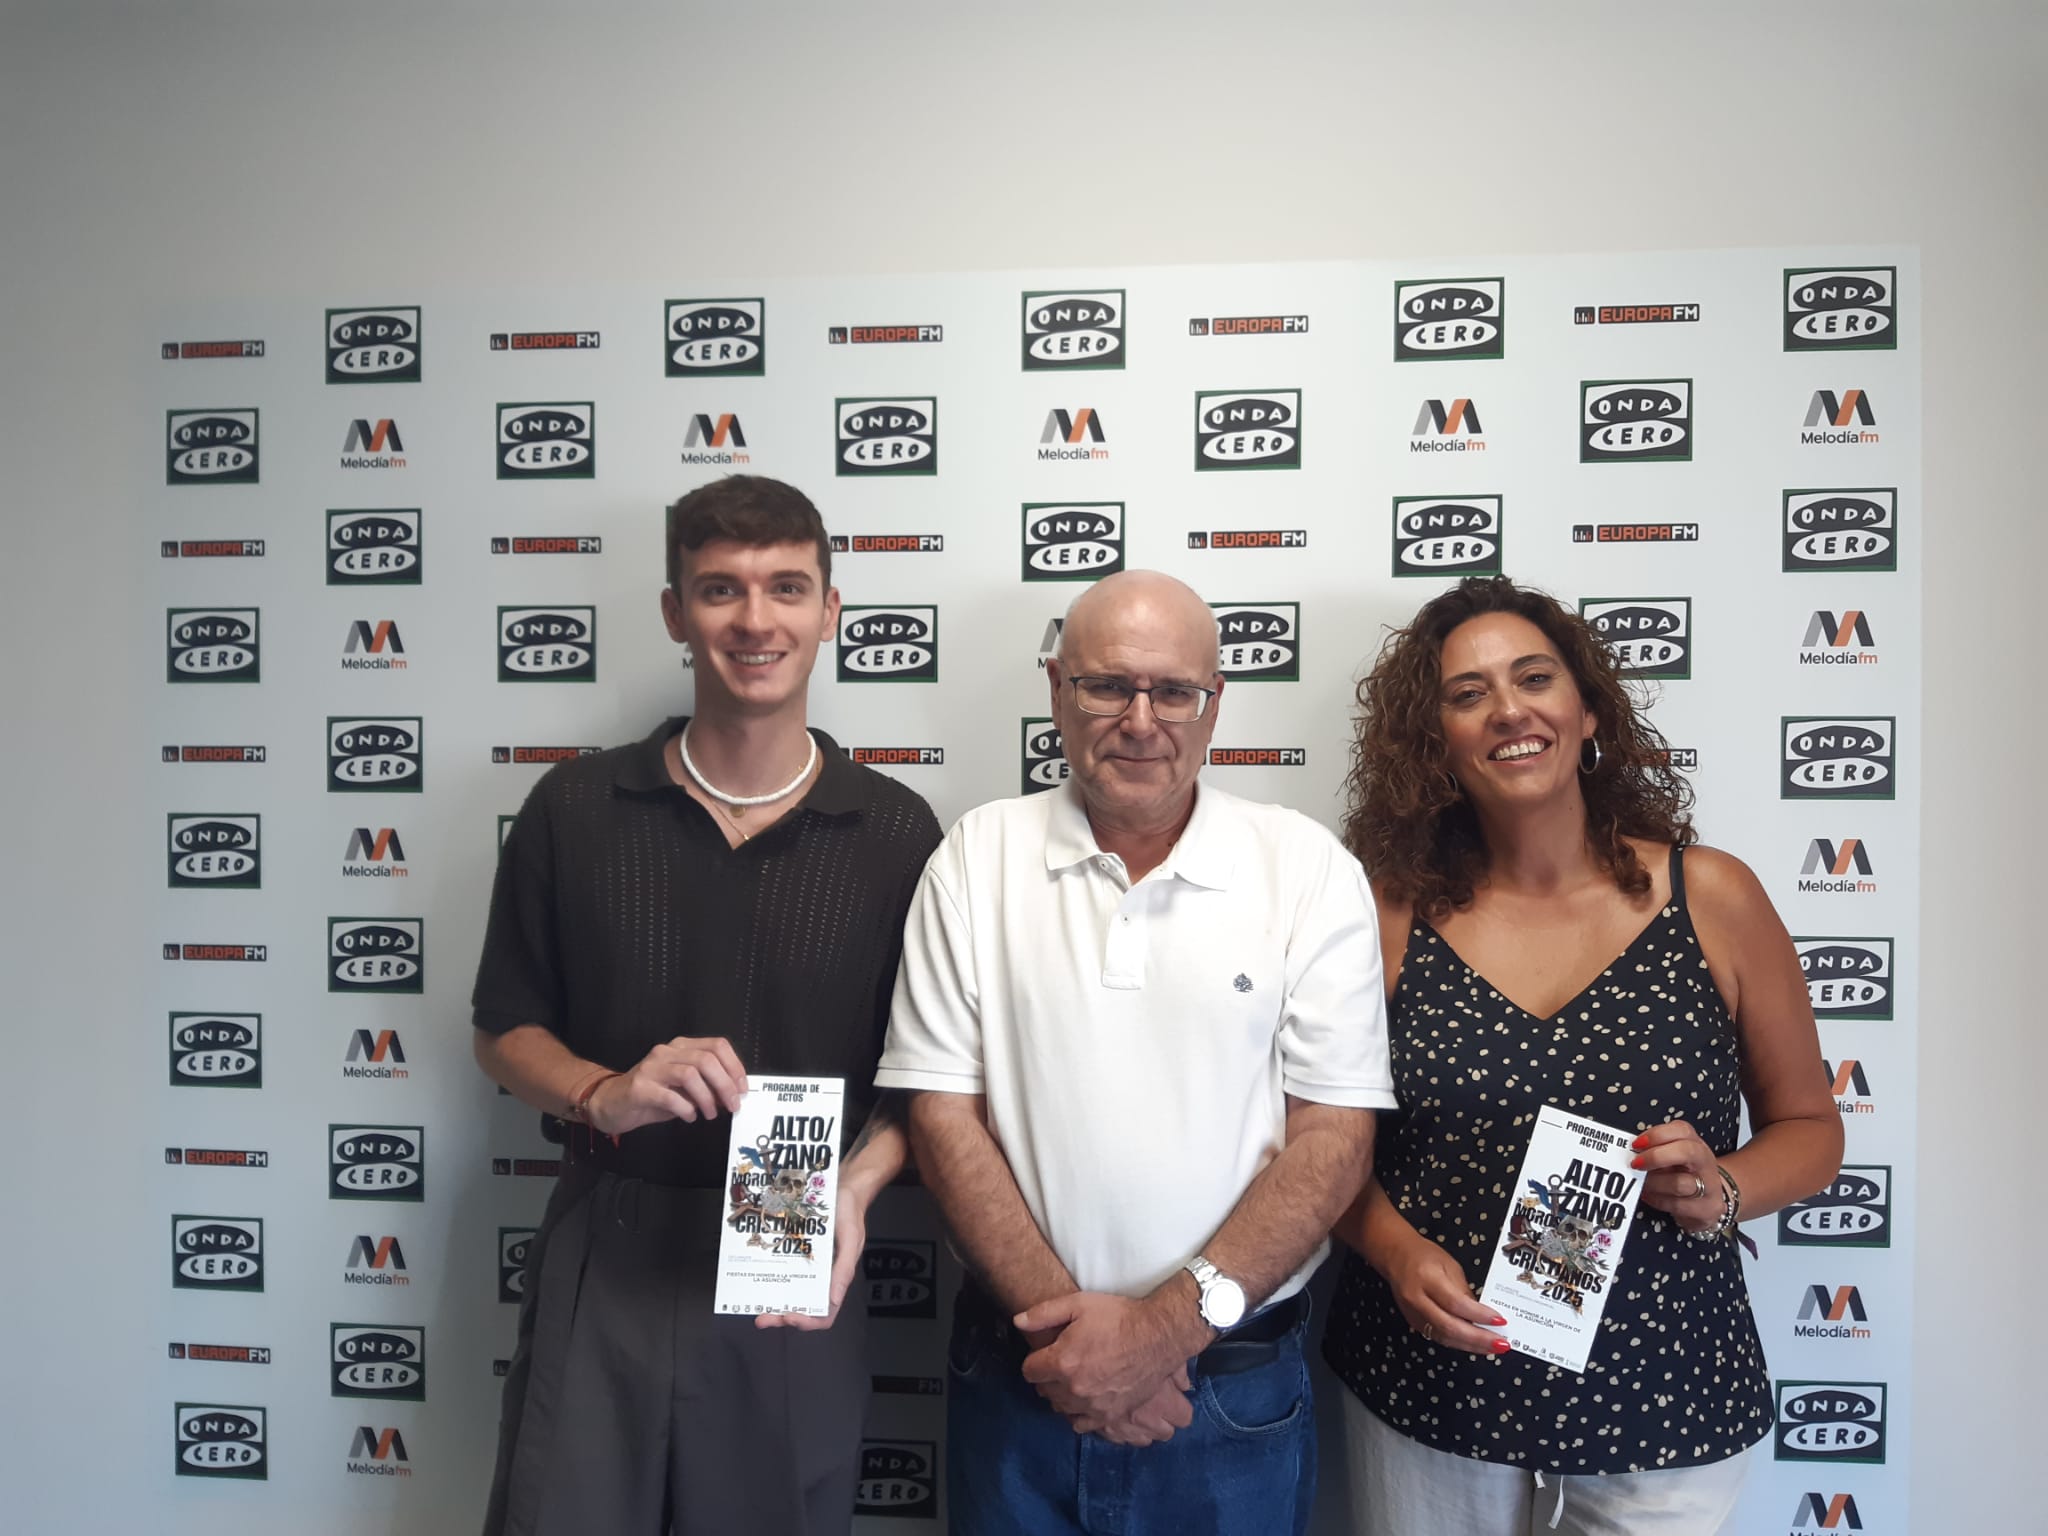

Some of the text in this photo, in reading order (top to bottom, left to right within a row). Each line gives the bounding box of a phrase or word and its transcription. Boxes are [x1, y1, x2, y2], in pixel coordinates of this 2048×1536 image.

[1801, 285, 1877, 303] ONDA
[1411, 296, 1485, 314] ONDA
[680, 316, 747, 332] ONDA
[1038, 307, 1108, 325] ONDA
[1805, 314, 1878, 334] CERO
[340, 323, 404, 340] ONDA
[1415, 325, 1485, 345] CERO
[684, 343, 748, 361] CERO
[1042, 335, 1108, 355] CERO
[344, 350, 405, 369] CERO
[1598, 397, 1673, 415] ONDA
[851, 415, 919, 431] ONDA
[1211, 407, 1283, 425] ONDA
[181, 425, 243, 441] ONDA
[511, 419, 577, 435] ONDA
[1602, 426, 1673, 446] CERO
[855, 442, 919, 460] CERO
[1215, 435, 1283, 455] CERO
[184, 451, 243, 469] CERO
[515, 446, 578, 464] CERO
[1409, 513, 1483, 531] ONDA
[1801, 507, 1877, 524] ONDA
[341, 526, 405, 541] ONDA
[1037, 520, 1107, 537] ONDA
[1413, 541, 1483, 561] CERO
[1805, 535, 1877, 555] CERO
[345, 552, 405, 570] CERO
[1042, 547, 1107, 565] CERO
[181, 625, 243, 639] ONDA
[513, 623, 579, 638] ONDA
[852, 623, 920, 638] ONDA
[1597, 616, 1671, 632] ONDA
[185, 650, 244, 668] CERO
[517, 649, 579, 667] CERO
[856, 649, 921, 667] CERO
[1220, 648, 1281, 665] ERO
[1620, 645, 1671, 662] ERO
[342, 733, 406, 749] ONDA
[1799, 735, 1875, 751] ONDA
[345, 759, 407, 777] CERO
[1042, 763, 1069, 779] CE
[1803, 763, 1876, 783] CERO
[182, 830, 244, 845] ONDA
[185, 856, 245, 873] CERO
[343, 934, 407, 949] ONDA
[346, 960, 407, 977] CERO
[1809, 984, 1874, 1002] ERO
[183, 1029, 245, 1043] ONDA
[187, 1055, 246, 1071] CERO
[763, 1083, 820, 1093] PROGRAMA DE
[777, 1093, 804, 1102] ACTOS
[770, 1115, 835, 1143] ALTO/
[1566, 1121, 1628, 1149] PROGRAMA DE
[343, 1141, 407, 1157] ONDA
[1579, 1136, 1609, 1153] ACTOS
[771, 1143, 832, 1171] ZANO
[347, 1168, 408, 1185] CERO
[1562, 1158, 1637, 1202] ALTO/
[1817, 1183, 1871, 1197] NDA
[1559, 1187, 1626, 1230] ZANO
[1799, 1211, 1871, 1229] CERO
[186, 1232, 247, 1247] ONDA
[772, 1237, 812, 1255] 2025
[190, 1258, 248, 1275] CERO
[867, 1256, 919, 1270] NDA
[871, 1282, 920, 1299] ERO
[1541, 1281, 1585, 1308] 2025
[345, 1340, 408, 1355] ONDA
[349, 1367, 409, 1384] CERO
[1793, 1399, 1867, 1415] ONDA
[189, 1419, 251, 1435] ONDA
[1796, 1427, 1867, 1445] CERO
[193, 1445, 251, 1463] CERO
[867, 1456, 919, 1471] NDA
